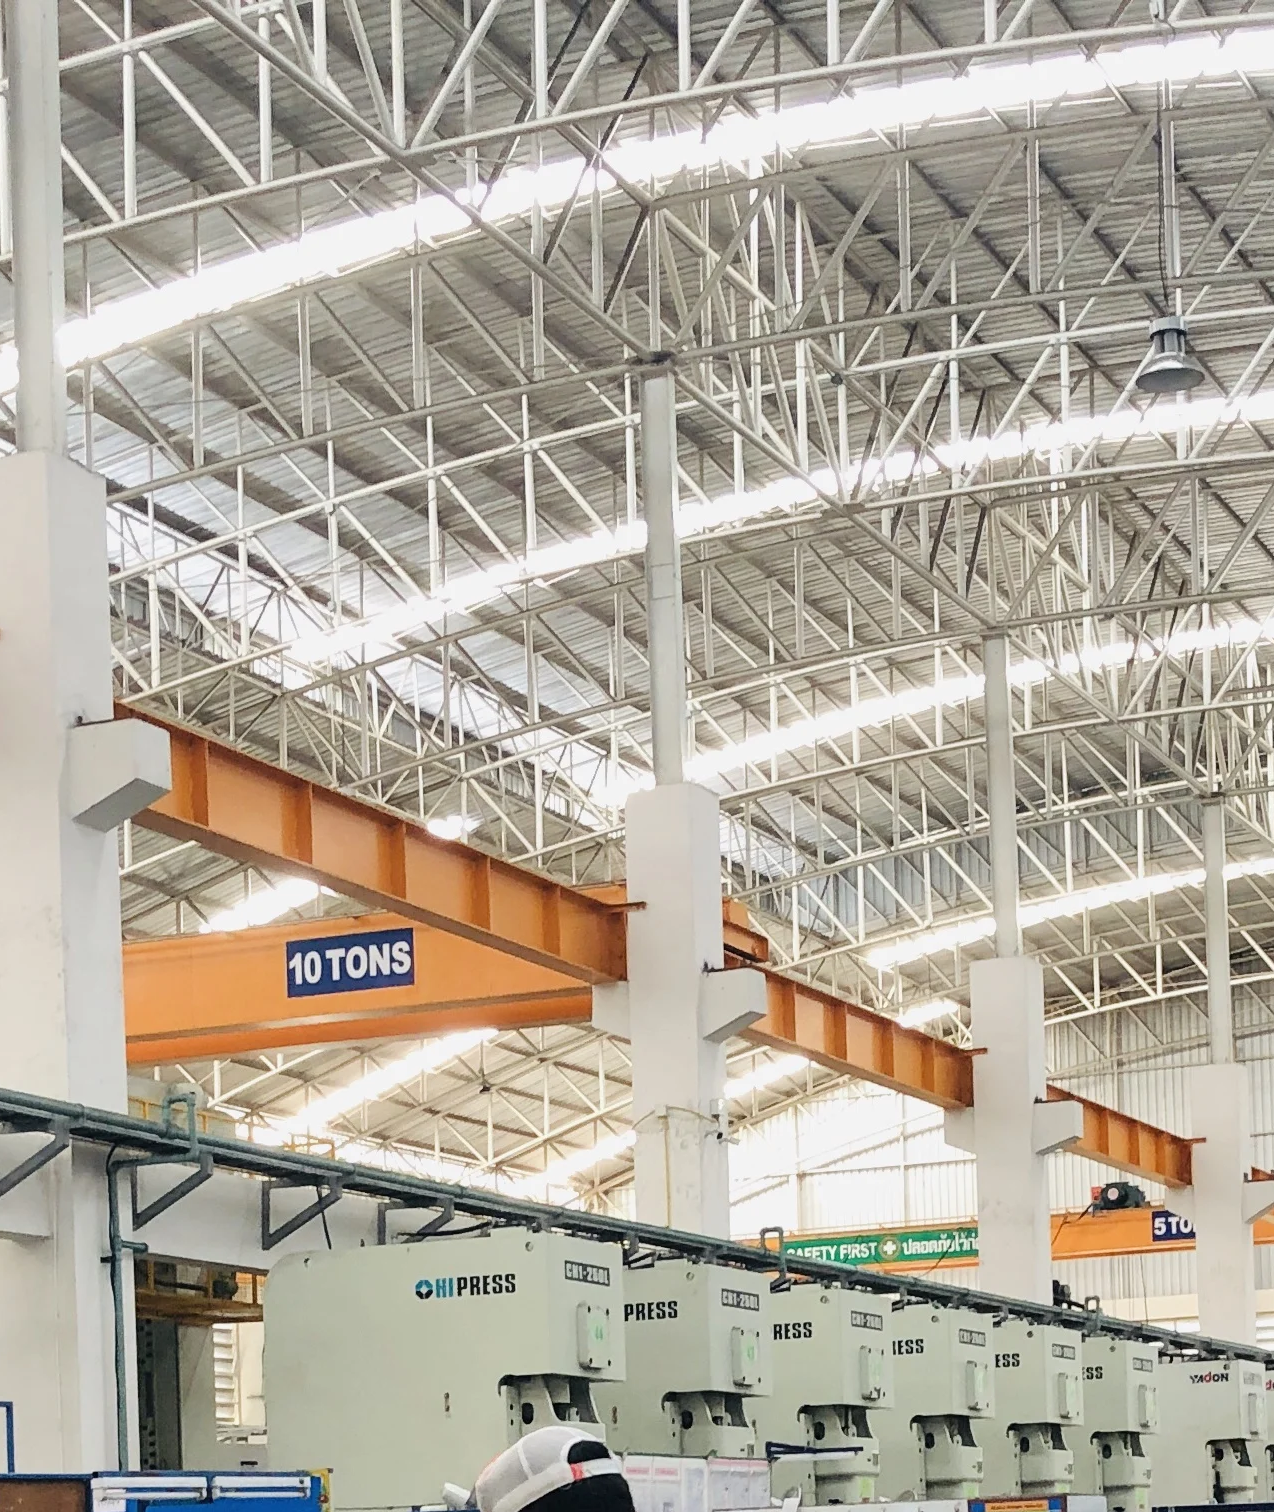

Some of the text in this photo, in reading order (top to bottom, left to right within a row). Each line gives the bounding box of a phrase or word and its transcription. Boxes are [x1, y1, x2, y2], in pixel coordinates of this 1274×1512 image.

[289, 940, 412, 985] 10 TONS
[1154, 1216, 1197, 1236] 5 TO
[839, 1242, 878, 1260] FIRST
[623, 1300, 678, 1322] PRESS
[773, 1321, 813, 1341] RESS
